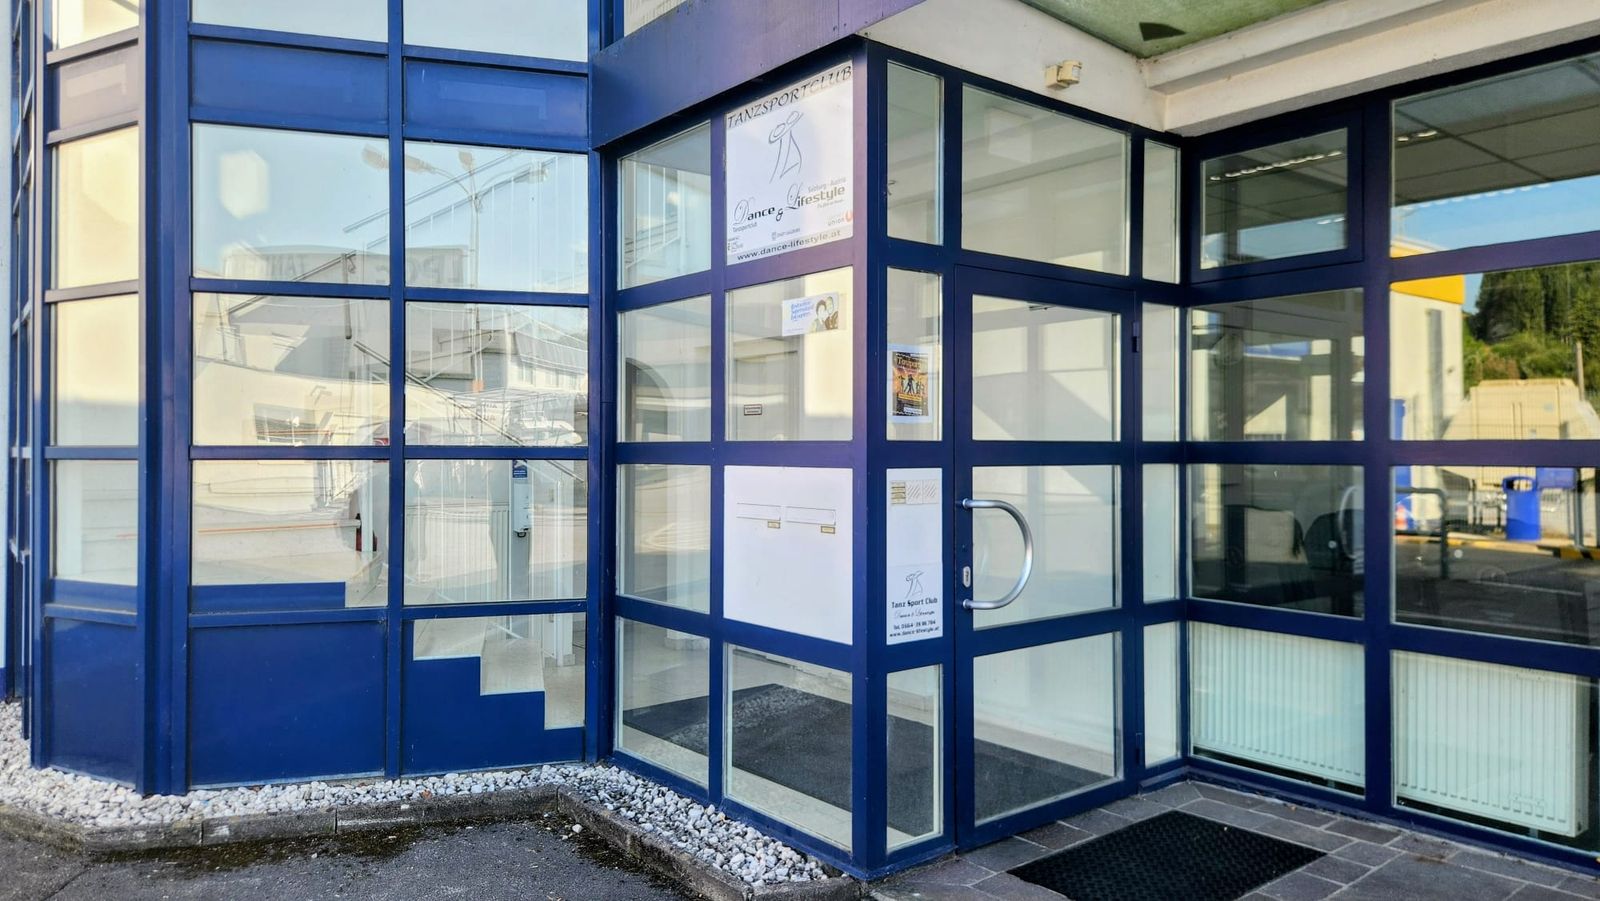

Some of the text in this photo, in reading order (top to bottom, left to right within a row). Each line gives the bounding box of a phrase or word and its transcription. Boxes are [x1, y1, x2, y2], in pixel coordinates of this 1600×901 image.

[727, 65, 852, 129] TANZSPORTCLUB
[732, 196, 775, 226] Dance
[786, 182, 845, 210] Lifestyle
[737, 229, 841, 261] www.dance-lifestyle.at
